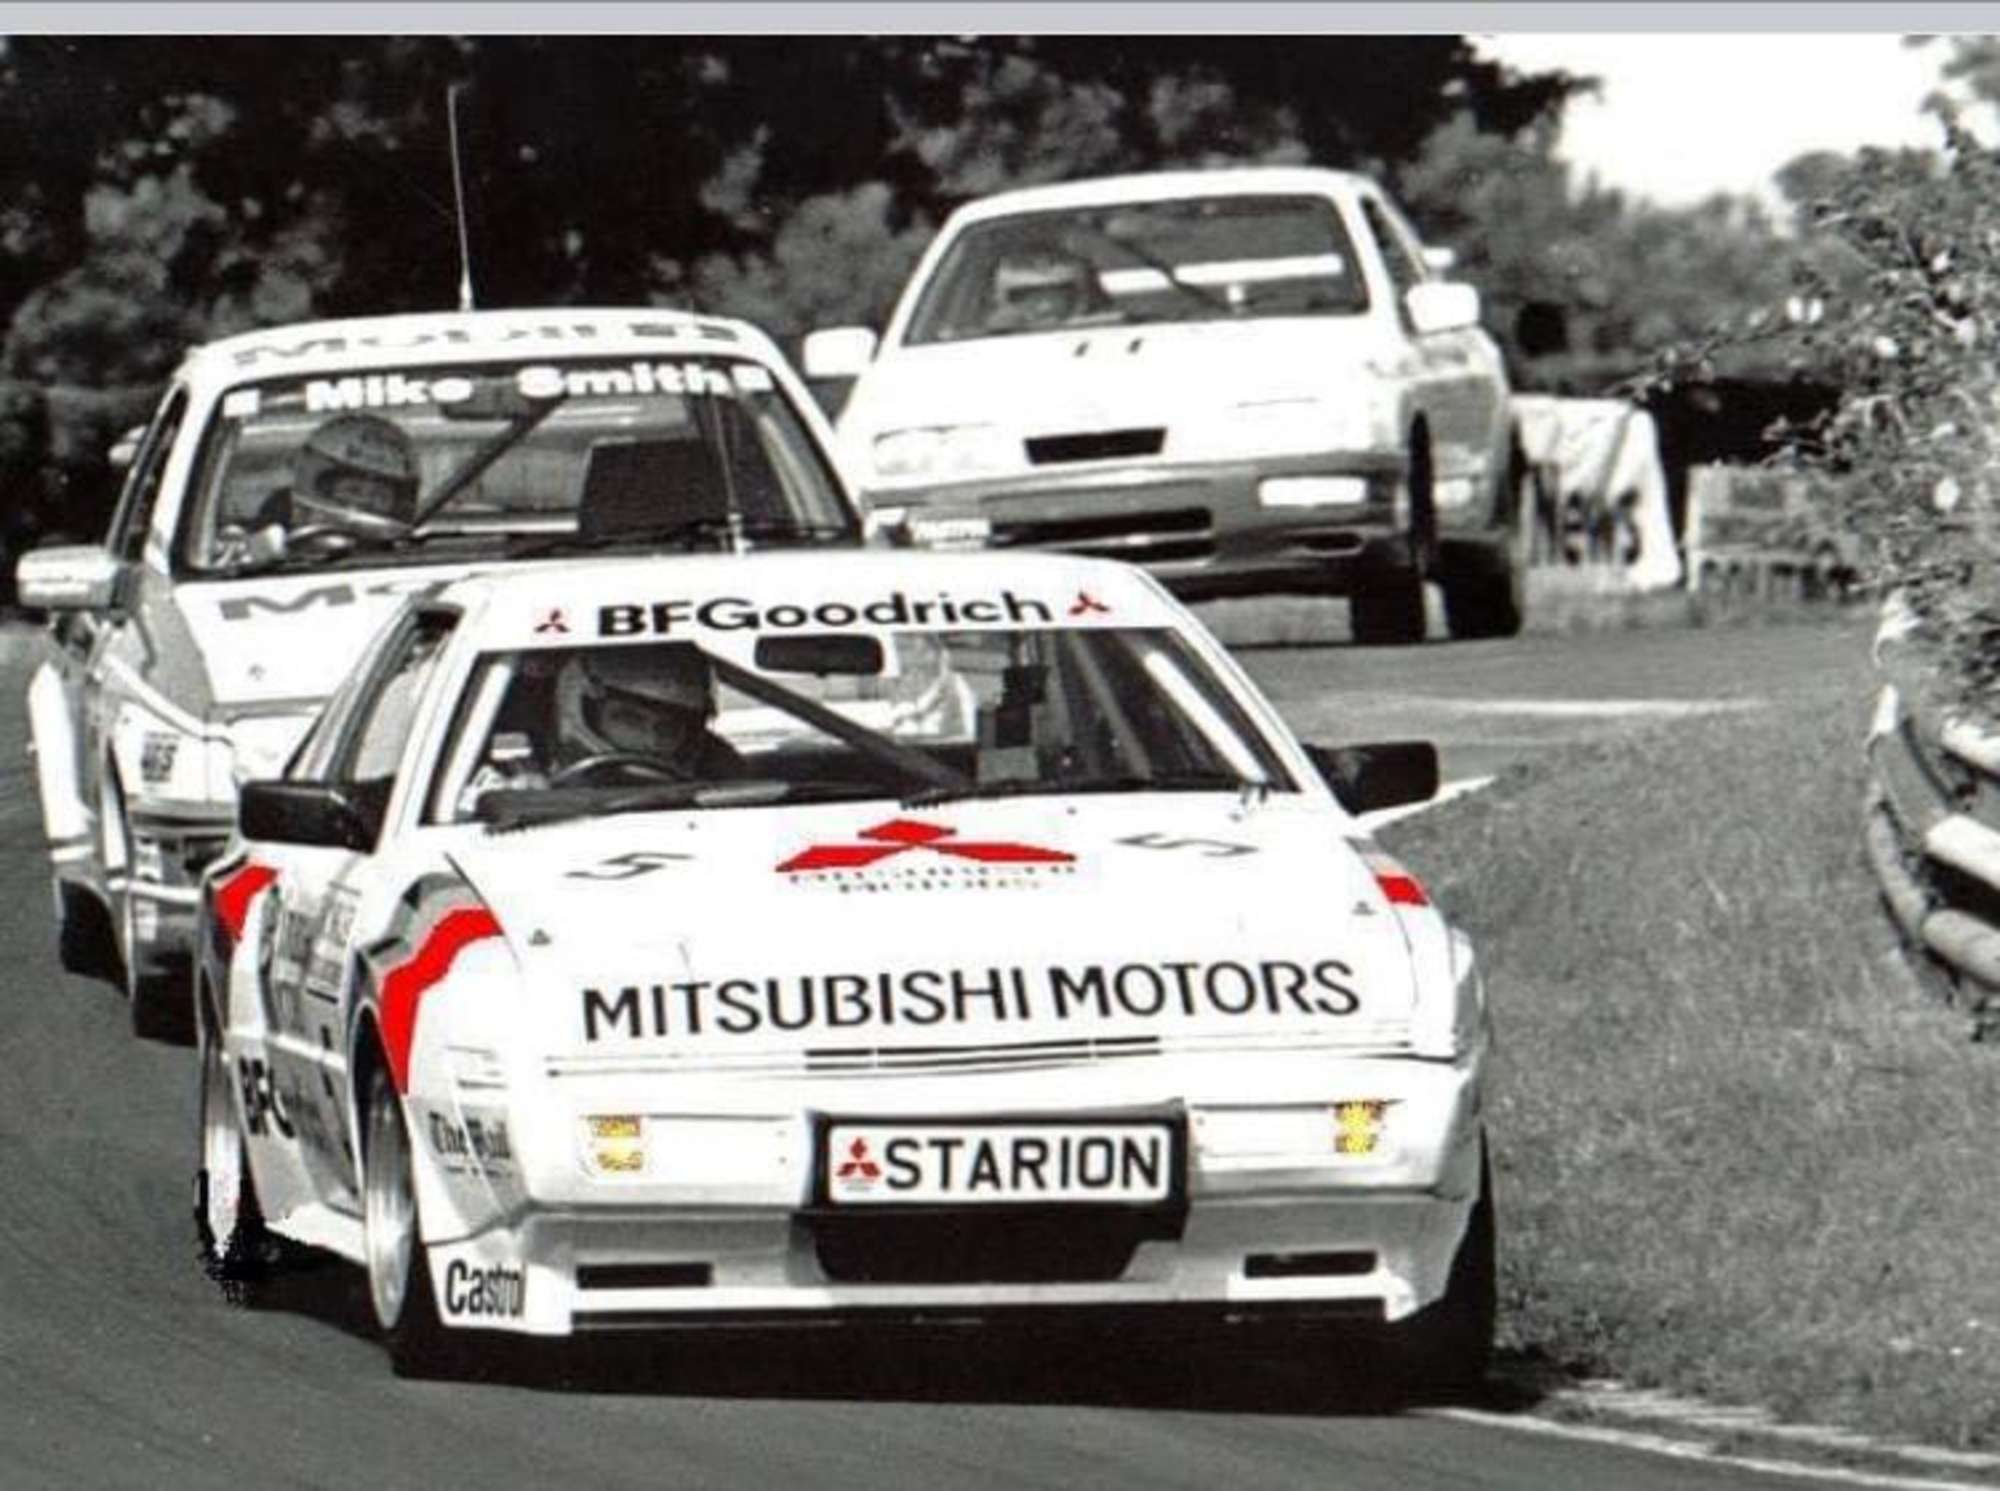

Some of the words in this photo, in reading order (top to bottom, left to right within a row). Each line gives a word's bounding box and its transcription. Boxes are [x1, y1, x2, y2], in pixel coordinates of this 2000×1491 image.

[305, 373, 473, 411] Mike
[517, 362, 733, 398] Smith
[598, 592, 1052, 637] BFGoodrich
[583, 967, 1032, 1041] MITSUBISHI
[1048, 960, 1360, 1018] MOTORS
[885, 1137, 1159, 1190] STARION
[446, 1258, 528, 1317] Castrol
